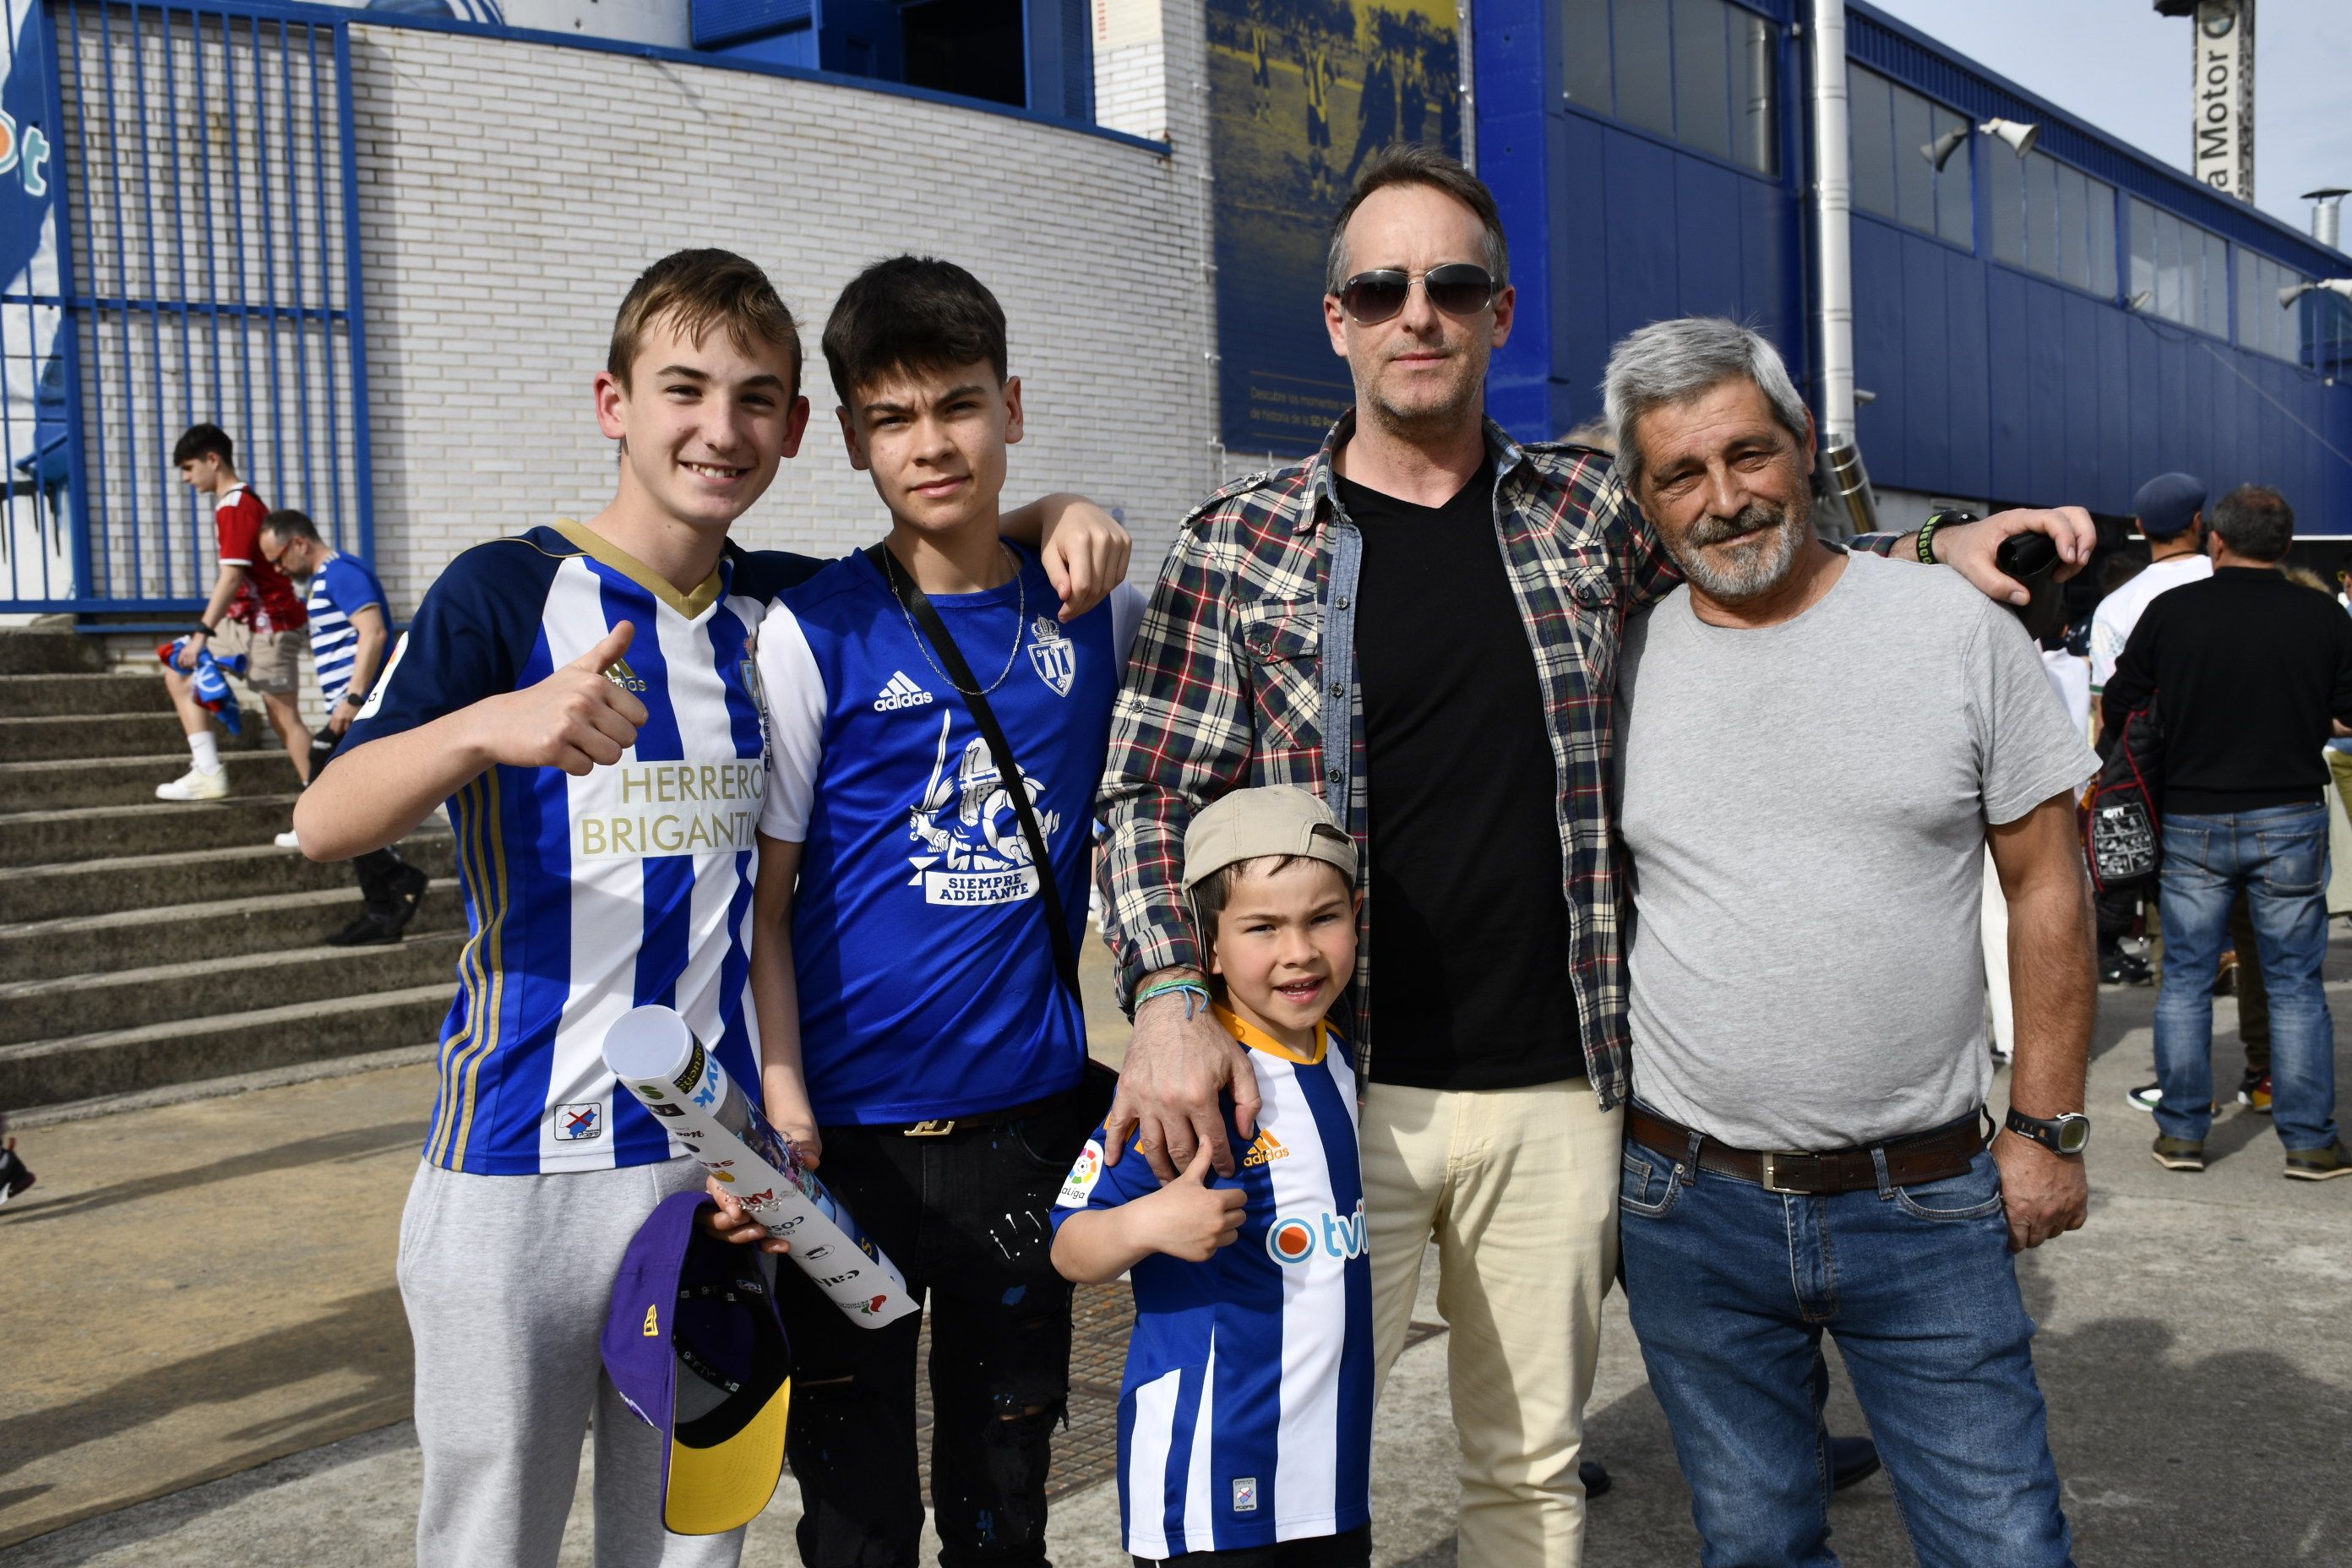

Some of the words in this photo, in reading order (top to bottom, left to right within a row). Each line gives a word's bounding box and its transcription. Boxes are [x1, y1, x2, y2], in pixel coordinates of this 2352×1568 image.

[2199, 50, 2229, 160] Motor
[874, 691, 934, 711] adidas
[623, 764, 764, 803] HERRERO
[939, 883, 1029, 901] ADELANTE
[948, 873, 1022, 890] SIEMPRE
[1243, 1146, 1290, 1168] adidas
[1061, 1187, 1086, 1200] aLiga
[1321, 1203, 1369, 1259] tvi
